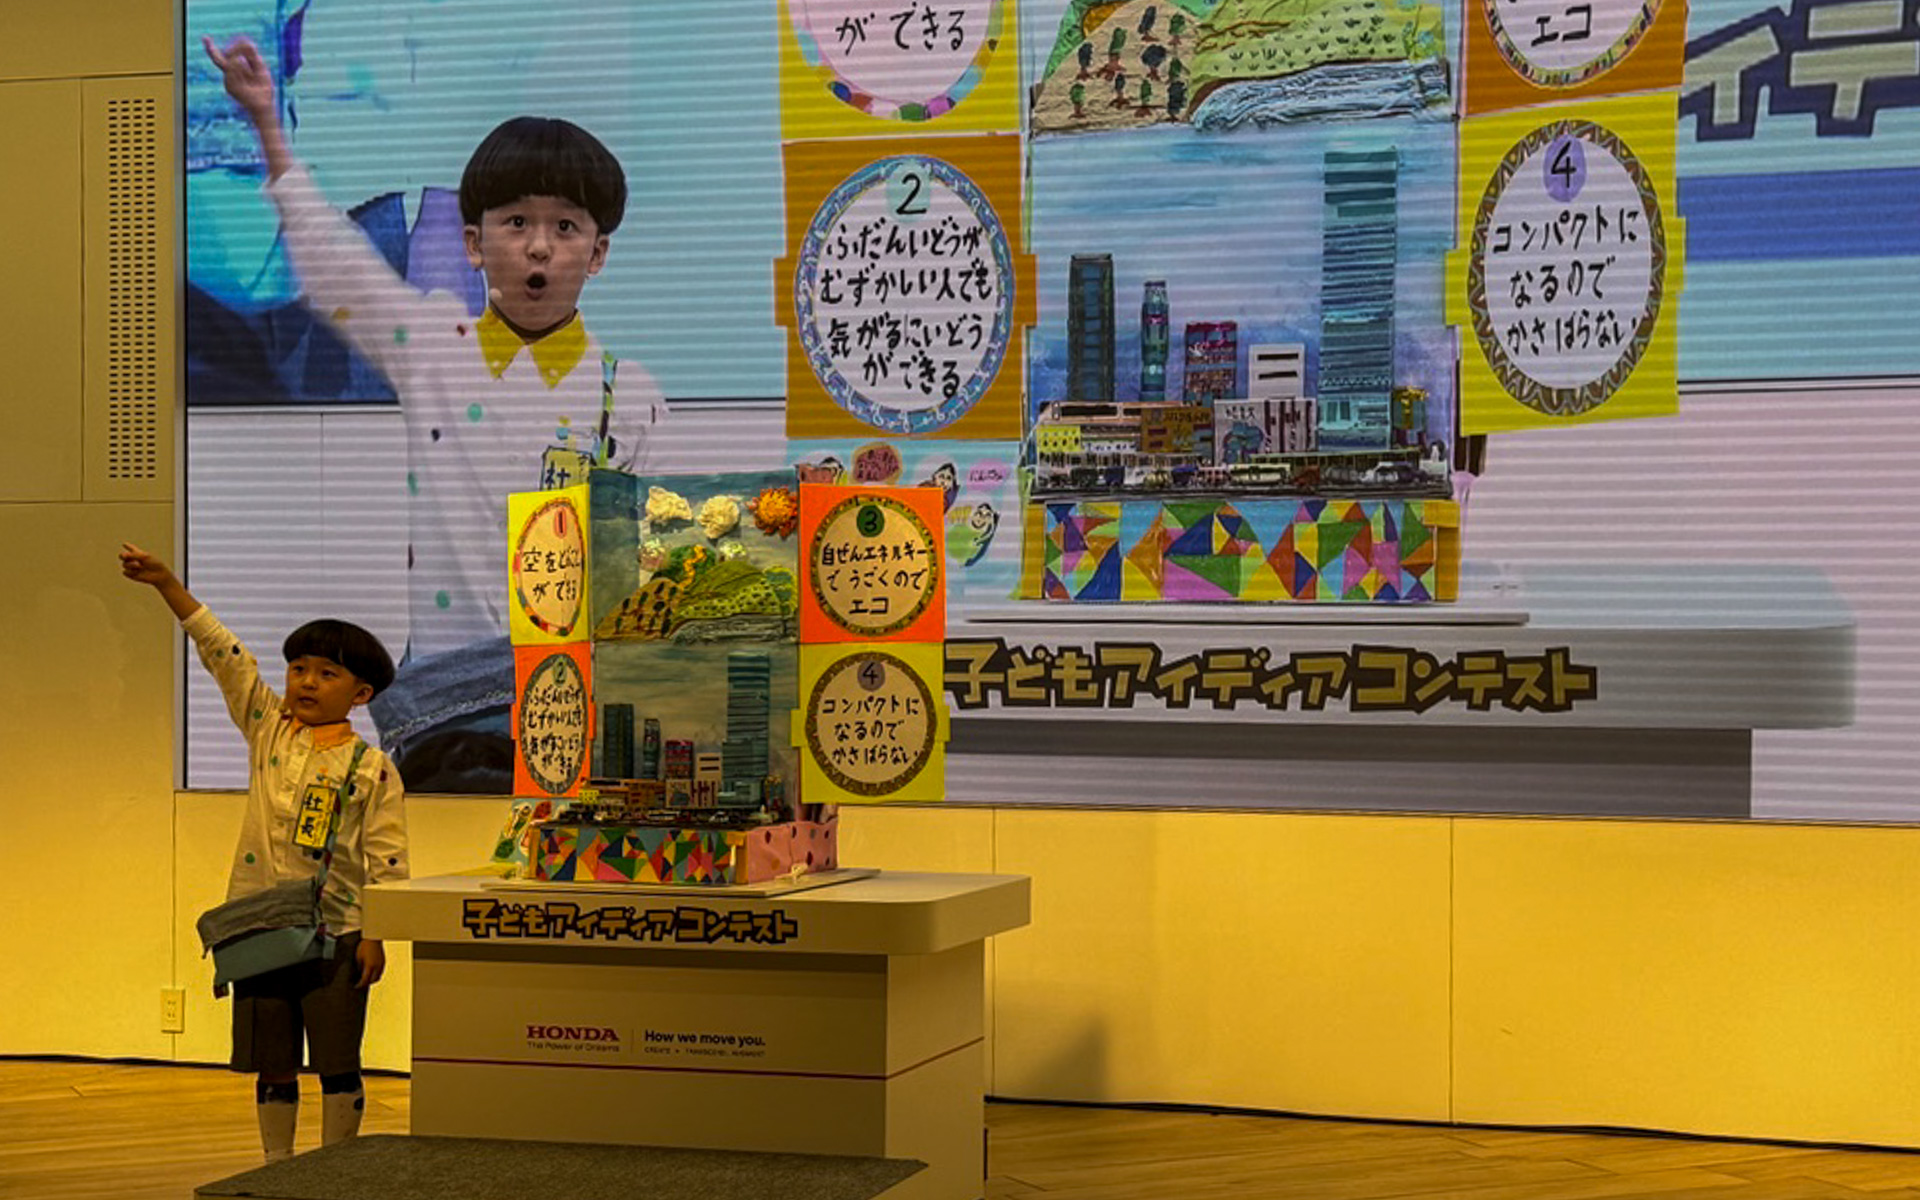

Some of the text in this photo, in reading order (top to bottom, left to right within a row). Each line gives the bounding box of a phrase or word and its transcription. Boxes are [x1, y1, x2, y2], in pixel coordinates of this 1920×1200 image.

[835, 1, 965, 56] ができる
[1531, 5, 1591, 48] エコ
[1550, 139, 1577, 189] 4
[895, 172, 929, 217] 2
[825, 213, 984, 260] ふだんいどうが
[1492, 204, 1640, 254] コンパクトに
[820, 260, 993, 306] むずかしい人でも
[1509, 256, 1616, 308] なるので
[827, 309, 984, 356] 気がるにいどう
[1507, 310, 1637, 356] かさばらない
[863, 354, 961, 398] ができる
[864, 510, 878, 533] 3
[822, 540, 928, 566] 自ぜんエネルギー
[826, 566, 928, 592] でうごくので
[849, 597, 889, 615] エコ
[862, 662, 879, 685] 4
[944, 637, 1597, 714] 子どもアイディアコンテスト
[822, 694, 920, 716] コンパクトに
[834, 719, 905, 741] なるので
[832, 745, 919, 766] かさばらない
[463, 898, 798, 944] 子どもアイディアコンテスト
[526, 1025, 619, 1042] HONDA
[545, 1042, 572, 1050] Power
[645, 1029, 766, 1048] How we move you.
